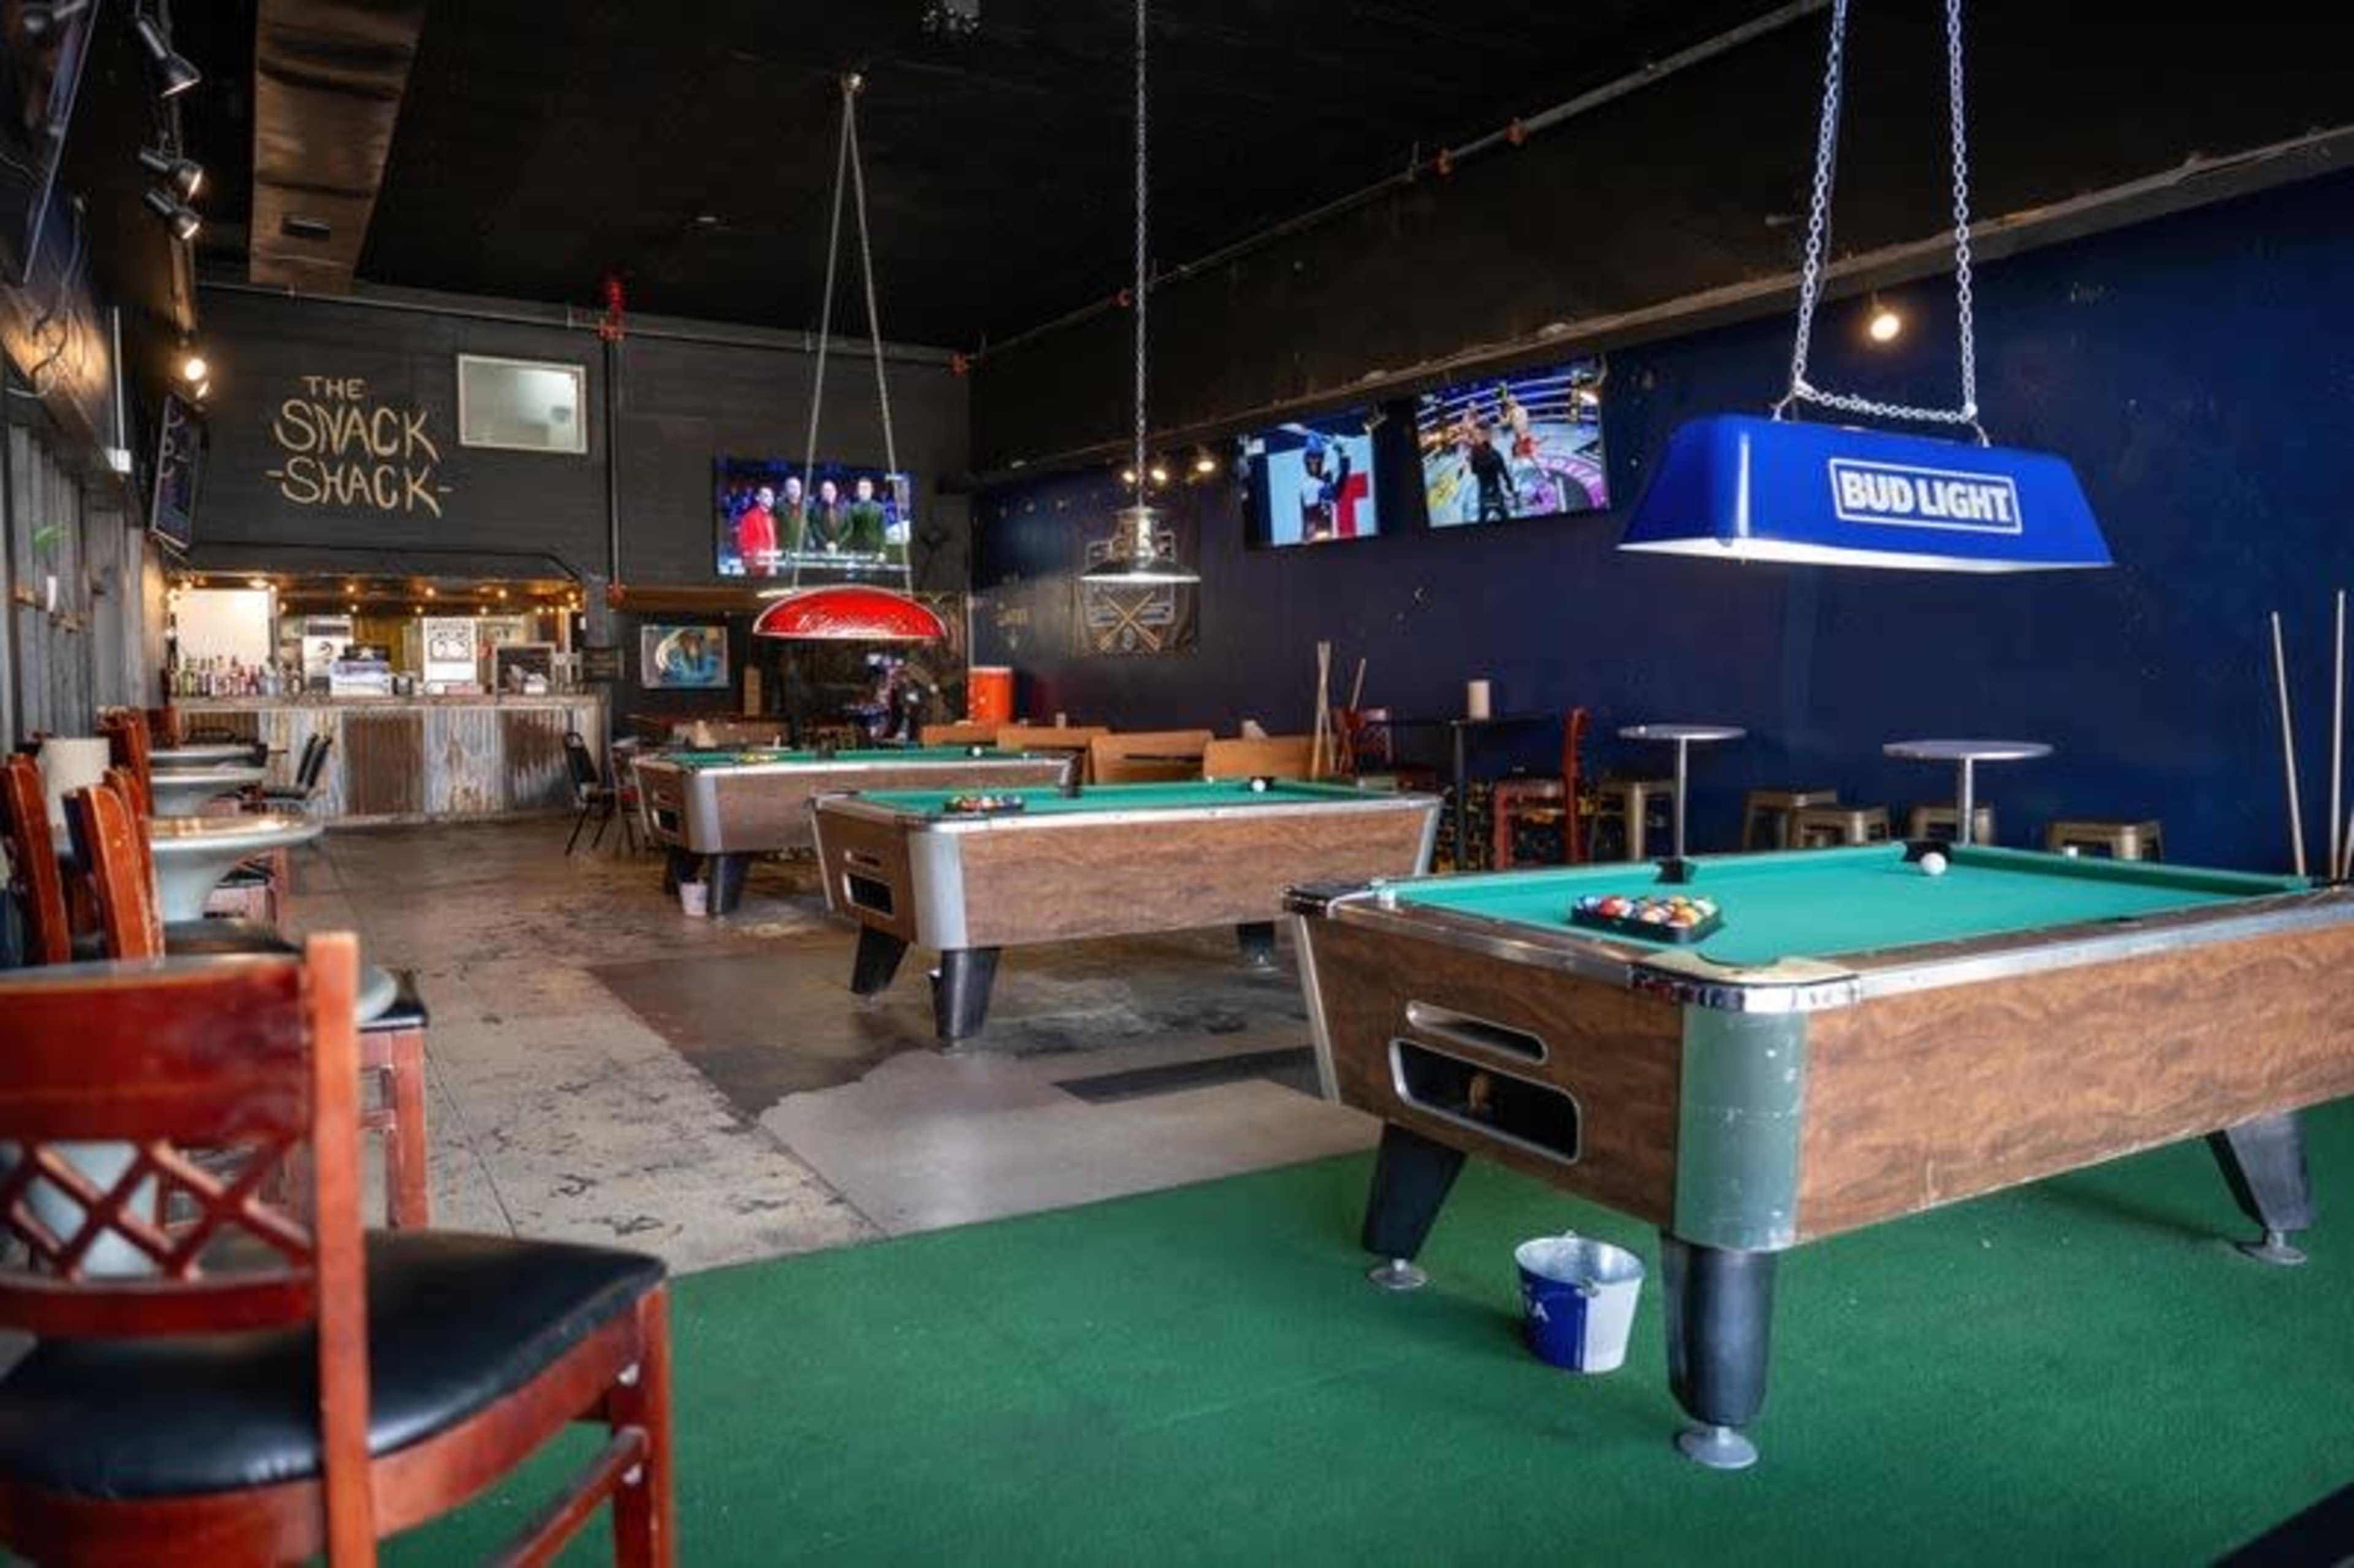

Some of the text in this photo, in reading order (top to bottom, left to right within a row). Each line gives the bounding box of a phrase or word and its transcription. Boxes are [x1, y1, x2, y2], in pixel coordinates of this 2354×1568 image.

[302, 376, 366, 398] THE
[274, 399, 440, 462] SNACK
[1839, 471, 2011, 522] BUD LIGHT
